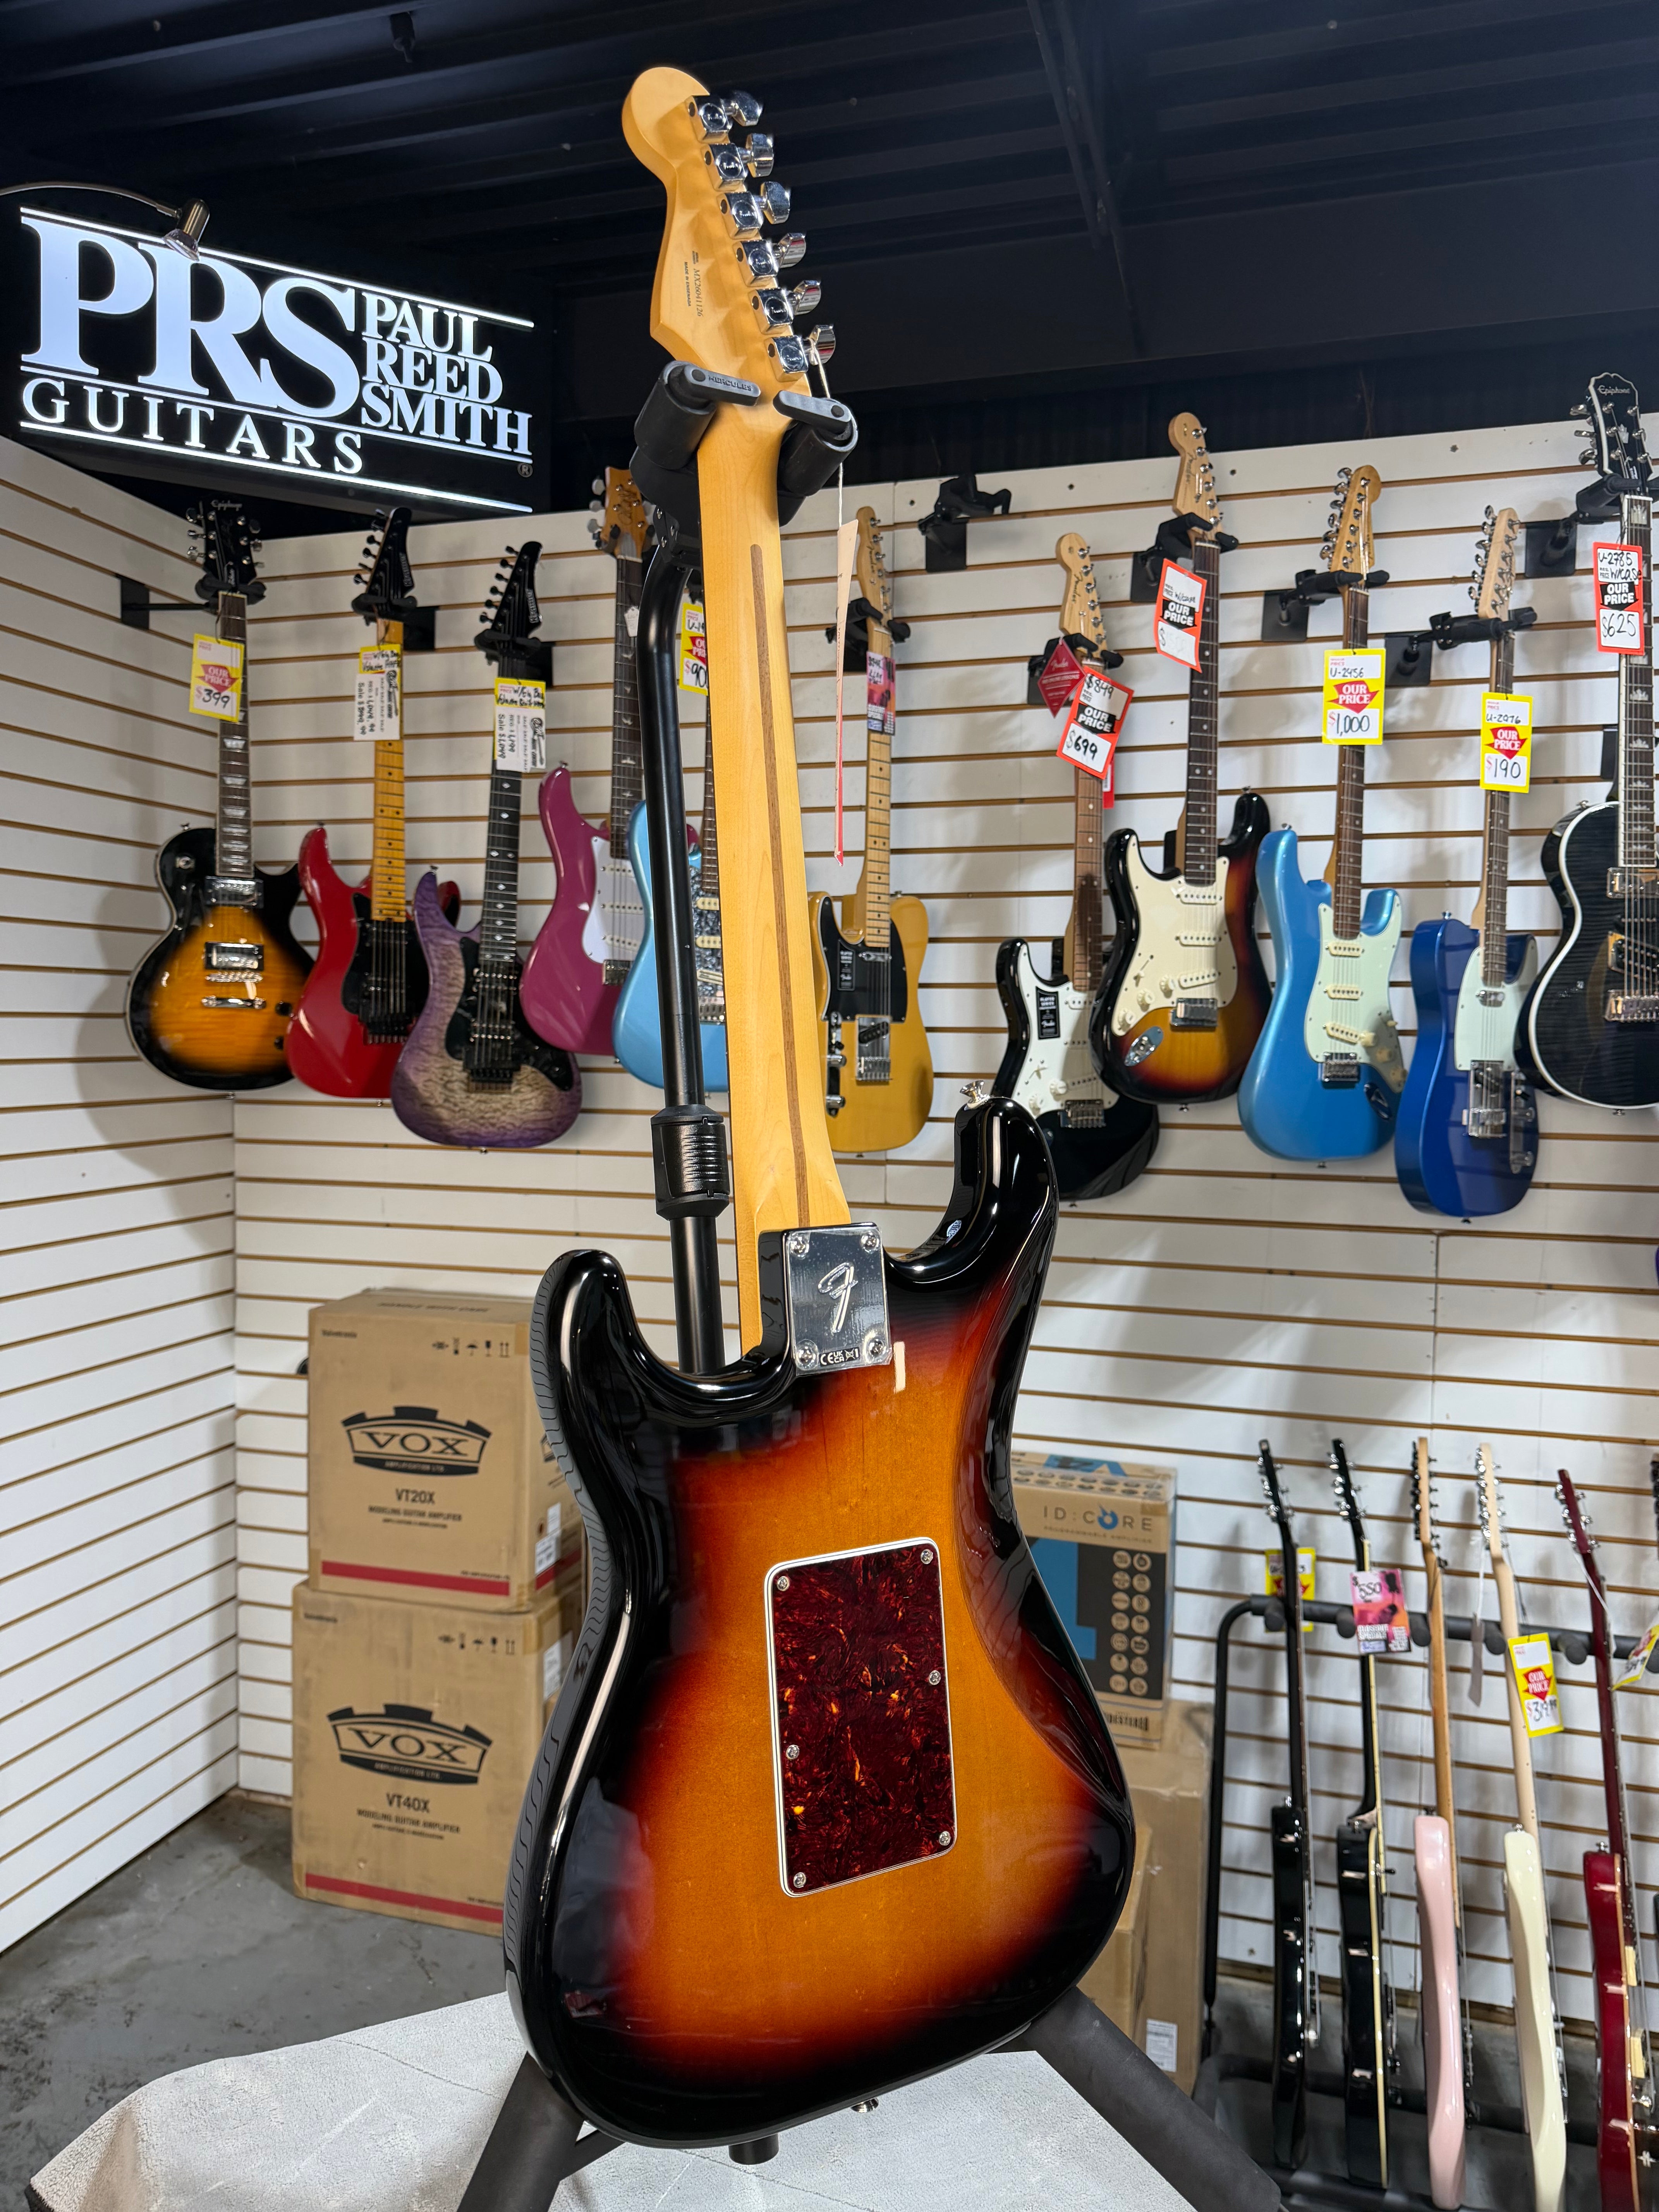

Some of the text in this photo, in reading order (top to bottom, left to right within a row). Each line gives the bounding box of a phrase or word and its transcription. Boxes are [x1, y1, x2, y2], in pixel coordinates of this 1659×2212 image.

[21, 216, 360, 418] PRS
[362, 292, 492, 362] PAUL
[363, 338, 502, 404] REED
[708, 375, 752, 391] HERCULES
[1597, 385, 1631, 396] Epiphone
[22, 378, 364, 475] GUITARS
[361, 383, 533, 455] SMITH
[1071, 571, 1083, 604] Fender
[1607, 583, 1629, 593] OUR
[1604, 593, 1635, 605] PRICE
[1168, 602, 1190, 616] OUR
[1163, 611, 1194, 627] PRICE
[1602, 613, 1636, 638] $625
[208, 666, 229, 677] OUR
[1330, 667, 1364, 678] U-2456
[205, 675, 232, 687] PRICE
[1085, 675, 1114, 699] $849
[196, 685, 230, 709] $399
[1342, 684, 1367, 695] OUR
[1338, 694, 1371, 704] PRICE
[1084, 706, 1109, 721] OUR
[1077, 715, 1113, 733] PRICE
[1329, 711, 1370, 737] $1,000
[1497, 729, 1518, 740] OUR
[1066, 729, 1097, 761] $699
[1494, 739, 1521, 751] PRICE
[1486, 756, 1521, 778] $190
[821, 1353, 834, 1365] CE
[360, 1431, 469, 1456] VOX
[395, 1489, 436, 1504] VT20X
[1528, 1671, 1546, 1683] OUR
[1528, 1679, 1549, 1693] PRICE
[349, 1728, 468, 1765] VOX
[386, 1792, 430, 1814] VT40X
